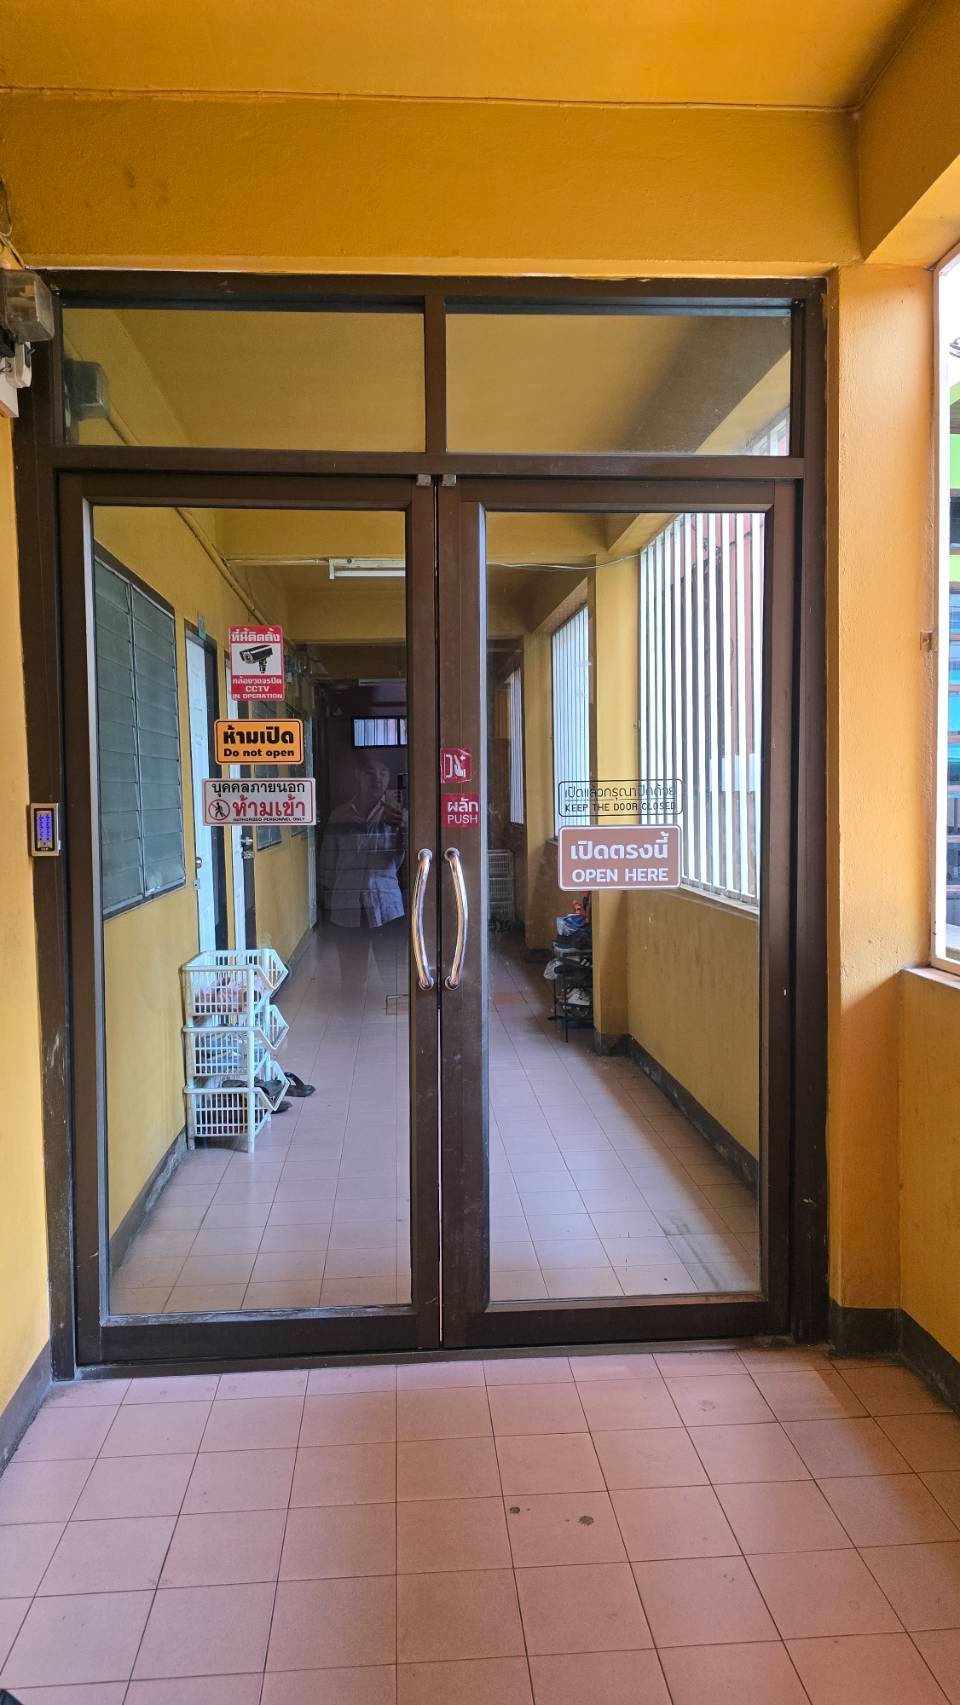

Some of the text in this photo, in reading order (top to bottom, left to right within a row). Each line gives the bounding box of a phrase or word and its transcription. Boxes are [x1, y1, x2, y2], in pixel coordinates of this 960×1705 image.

[223, 725, 294, 745] ห้ามเปิด
[223, 748, 295, 759] Do not open
[211, 783, 305, 798] บุคคลภายนอก
[232, 794, 306, 817] ห้ามเข้า
[447, 797, 479, 813] ผลัก
[564, 801, 676, 812] KEEP THE DOOR CLOSED
[447, 814, 478, 824] PUSH
[570, 831, 669, 860] เปิดตรงนี้
[571, 868, 669, 883] OPEN HERE
